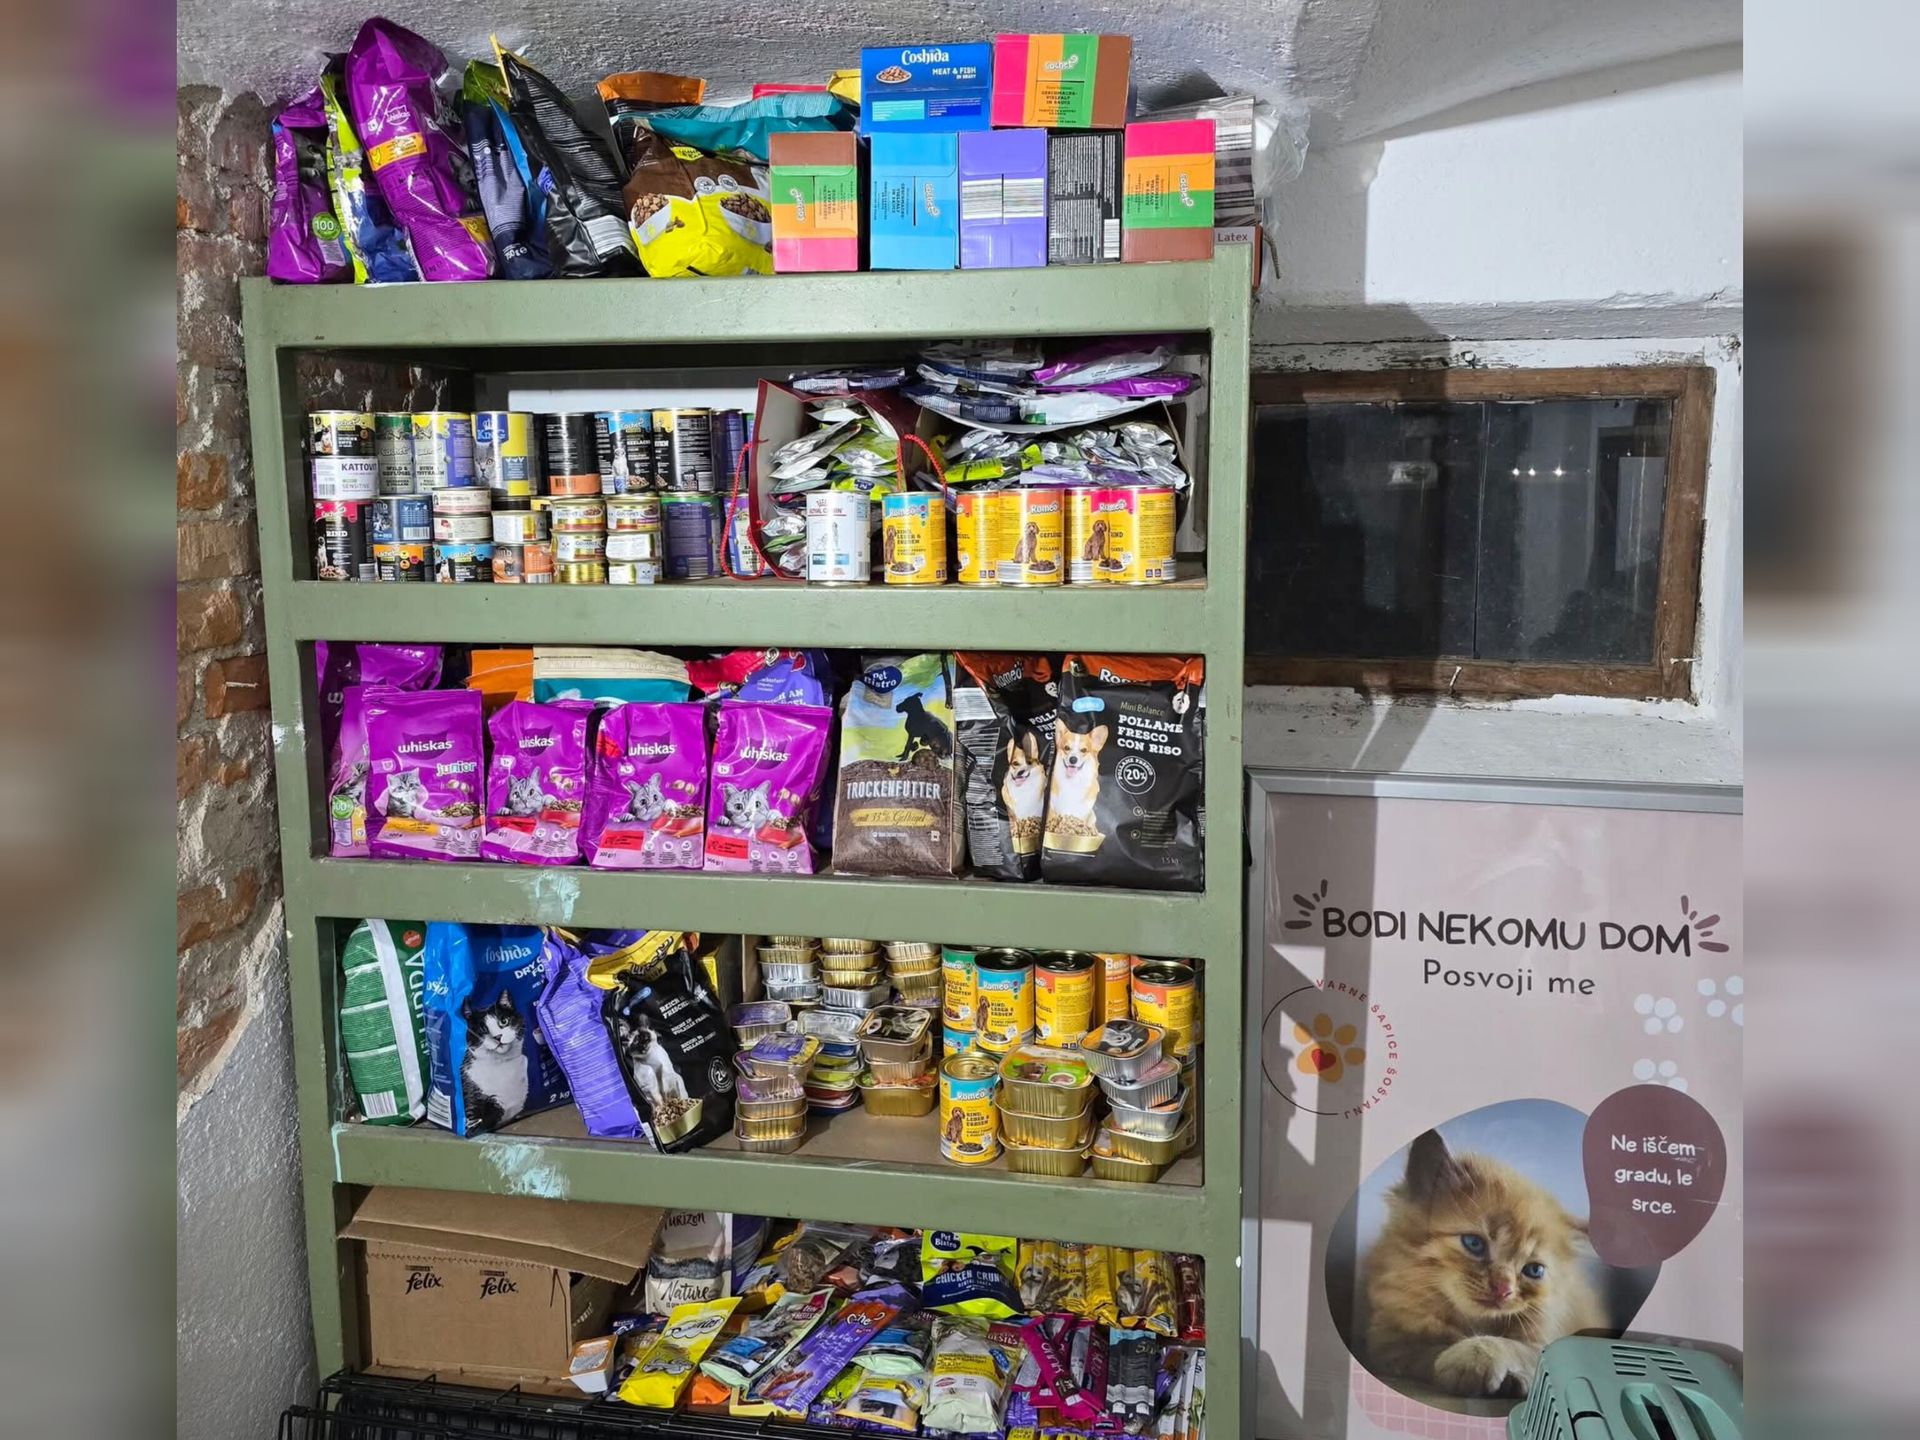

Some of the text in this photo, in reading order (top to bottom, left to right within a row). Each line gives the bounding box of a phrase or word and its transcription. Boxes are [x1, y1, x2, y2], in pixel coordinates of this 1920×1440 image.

[901, 48, 949, 65] Coshida
[932, 67, 950, 76] MEAT
[960, 66, 976, 74] FISH
[1217, 232, 1248, 242] Latex
[1031, 503, 1058, 514] Romeo
[1099, 500, 1127, 512] Romeo
[993, 668, 1025, 689] Romeo
[1120, 701, 1166, 717] Mini Balance
[1118, 714, 1184, 734] POLLAME
[518, 735, 555, 749] whiskas
[1117, 726, 1169, 743] FRESCO
[397, 739, 453, 754] whiskas
[628, 741, 677, 757] whiskas
[740, 746, 789, 762] whiskas
[1117, 738, 1182, 757] CON RISO
[436, 760, 477, 777] junior
[847, 779, 942, 800] TROCKENFUTTER
[1323, 907, 1691, 957] BODI NEKOMU DOM
[514, 961, 537, 979] DRY
[1423, 959, 1596, 996] Posvoji me
[983, 980, 1010, 990] Romeo
[1316, 979, 1368, 1002] VARNE
[549, 1090, 570, 1103] 2 kg
[956, 1089, 986, 1100] Romeo
[1611, 1134, 1696, 1157] Ne iščem
[1614, 1166, 1693, 1188] gradu, le
[1632, 1197, 1678, 1216] srce.
[935, 1239, 957, 1249] Bistro
[940, 1233, 952, 1241] Pet
[405, 1272, 442, 1295] felix
[935, 1269, 973, 1285] CHICKEN
[480, 1277, 517, 1300] felix
[660, 1280, 709, 1301] Nature
